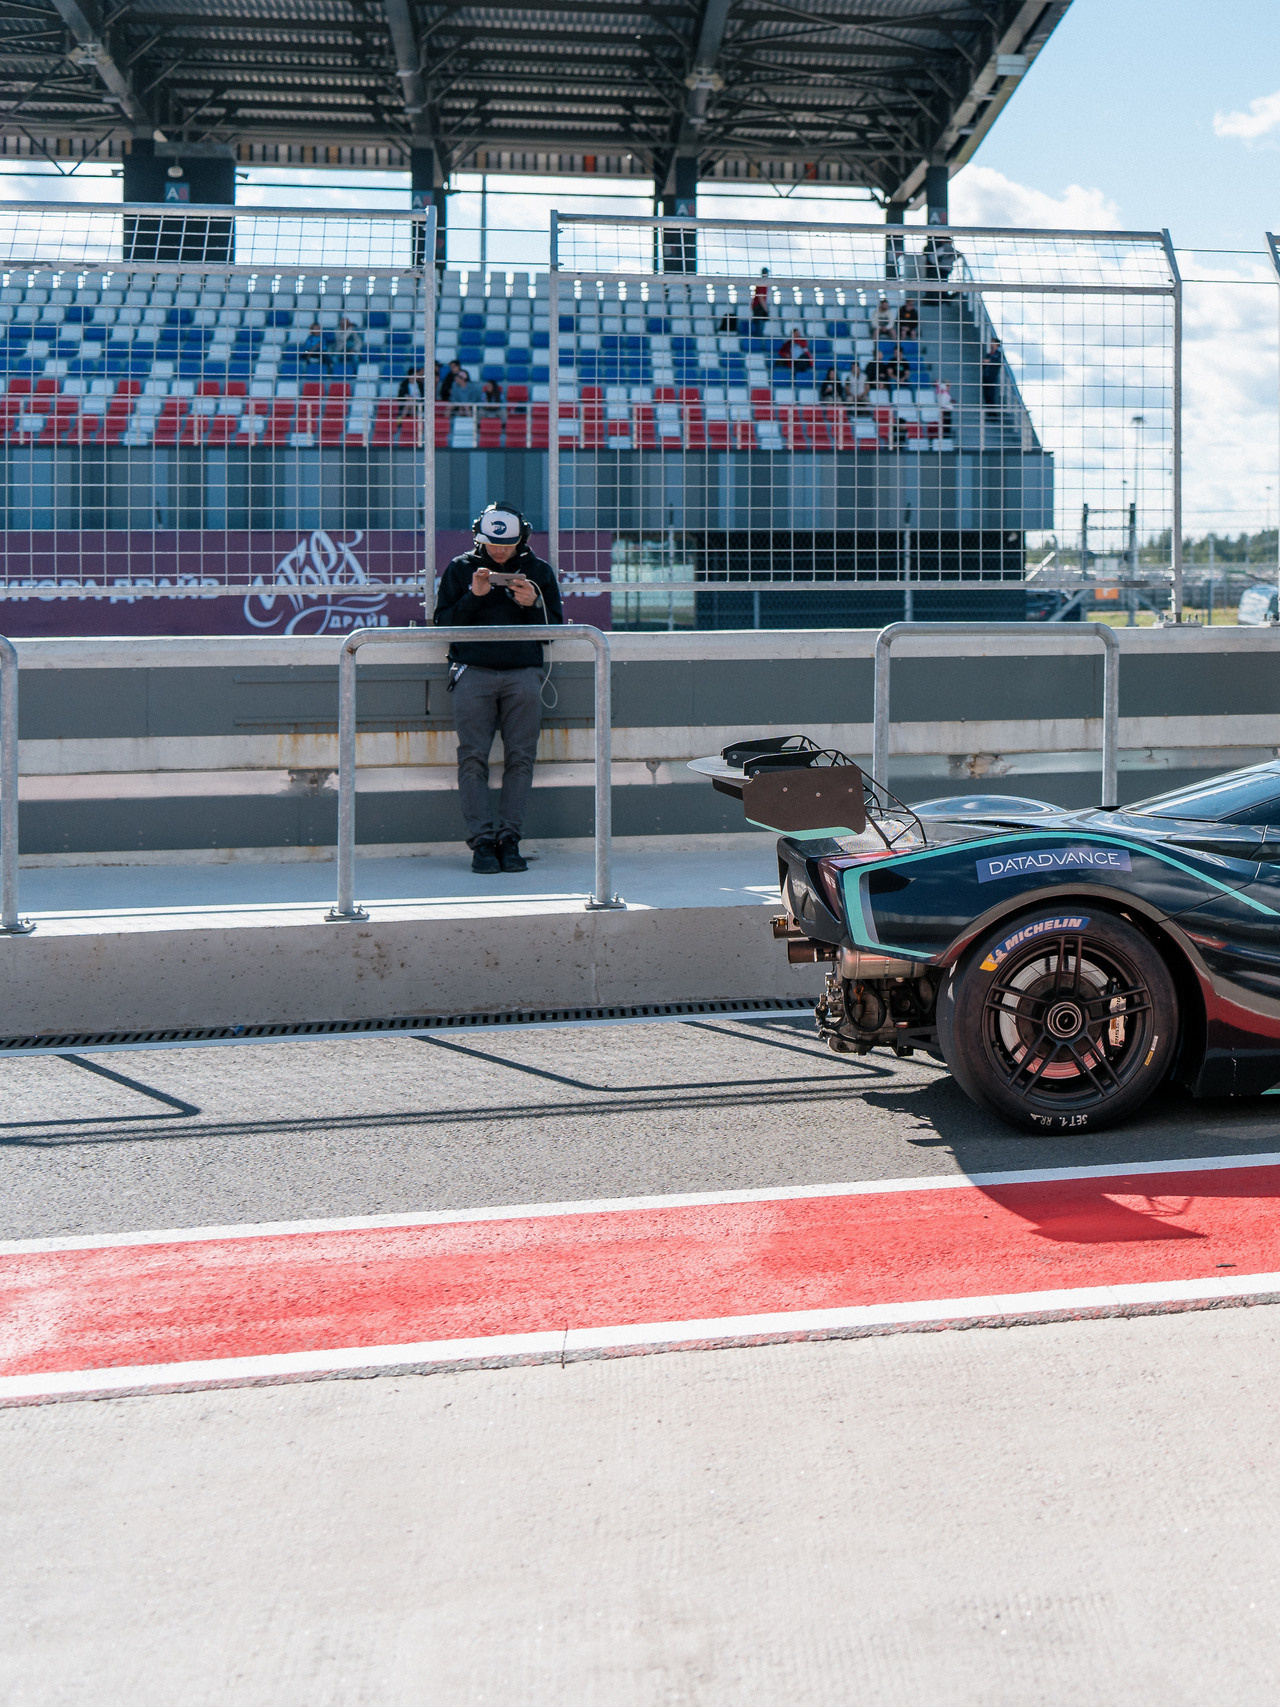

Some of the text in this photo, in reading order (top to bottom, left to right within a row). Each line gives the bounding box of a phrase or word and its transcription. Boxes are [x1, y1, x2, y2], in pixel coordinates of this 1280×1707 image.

[328, 612, 390, 629] ДРАЙВ
[988, 852, 1121, 875] DATADVANCE
[1004, 918, 1083, 951] MICHELIN
